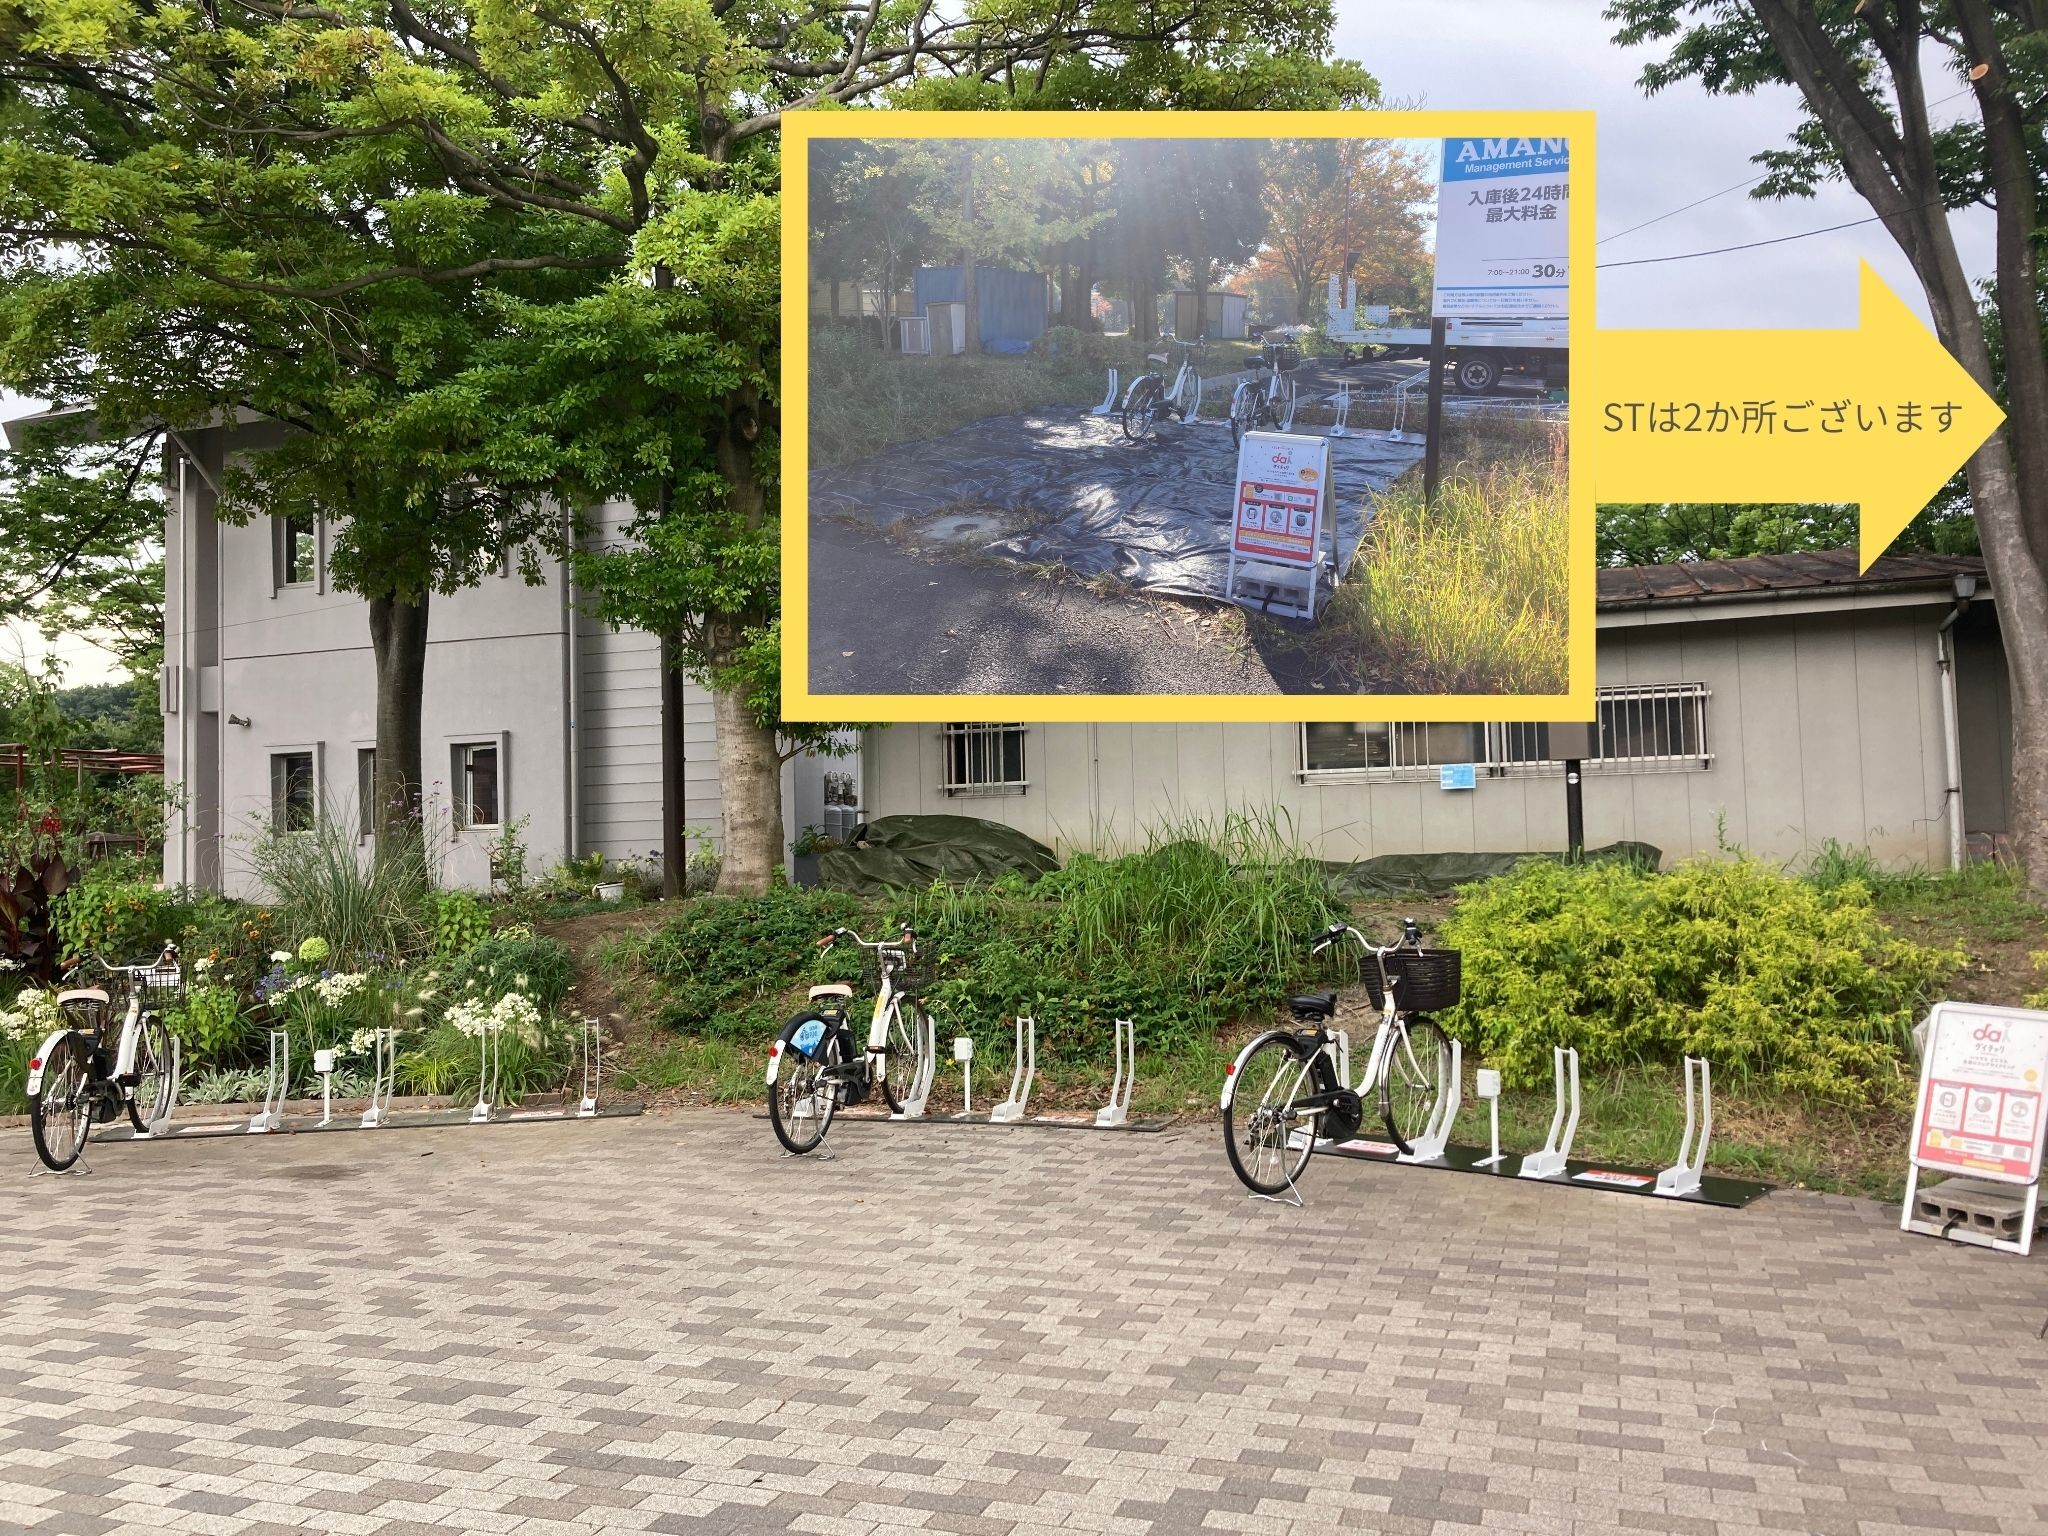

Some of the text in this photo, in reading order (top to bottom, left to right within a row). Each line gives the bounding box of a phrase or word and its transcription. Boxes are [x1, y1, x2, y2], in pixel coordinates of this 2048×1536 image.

[1465, 159, 1532, 173] Management
[1486, 204, 1557, 223] 最大料金
